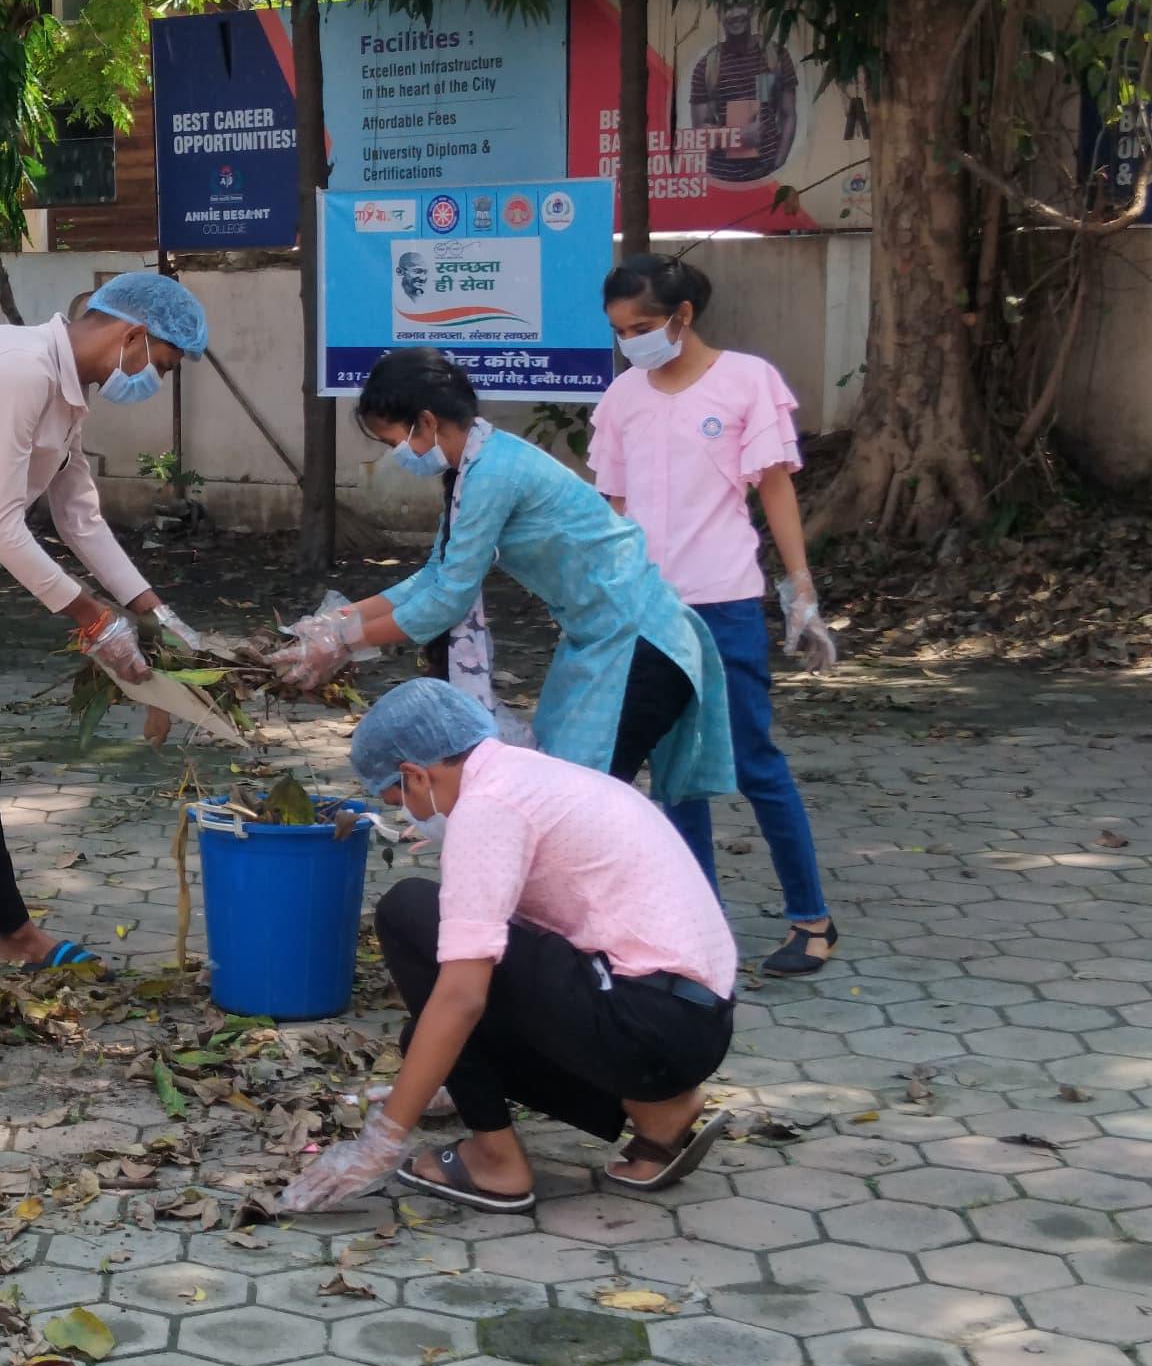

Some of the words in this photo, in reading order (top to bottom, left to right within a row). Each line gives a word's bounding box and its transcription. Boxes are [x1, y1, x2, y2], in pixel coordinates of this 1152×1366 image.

[360, 29, 461, 55] Facilities
[362, 64, 416, 80] Excellent
[420, 56, 503, 76] Infrastructure
[362, 85, 373, 100] in
[377, 82, 395, 99] the
[399, 82, 431, 97] heart
[434, 80, 446, 95] of
[449, 78, 468, 94] the
[472, 76, 497, 94] City
[172, 113, 210, 133] BEST
[214, 108, 274, 130] CAREER
[362, 113, 424, 131] Affordable
[428, 111, 457, 126] Fees
[173, 129, 297, 155] OPPORTUNITIES!
[363, 145, 422, 162] University
[426, 141, 477, 160] Diploma
[482, 139, 492, 154] &
[363, 165, 443, 182] Certifications
[184, 207, 221, 222] ANNIE
[435, 261, 501, 274] स्वच्छता
[435, 275, 454, 293] ही
[460, 276, 495, 291] सेवा
[484, 351, 550, 368] कॉलेज
